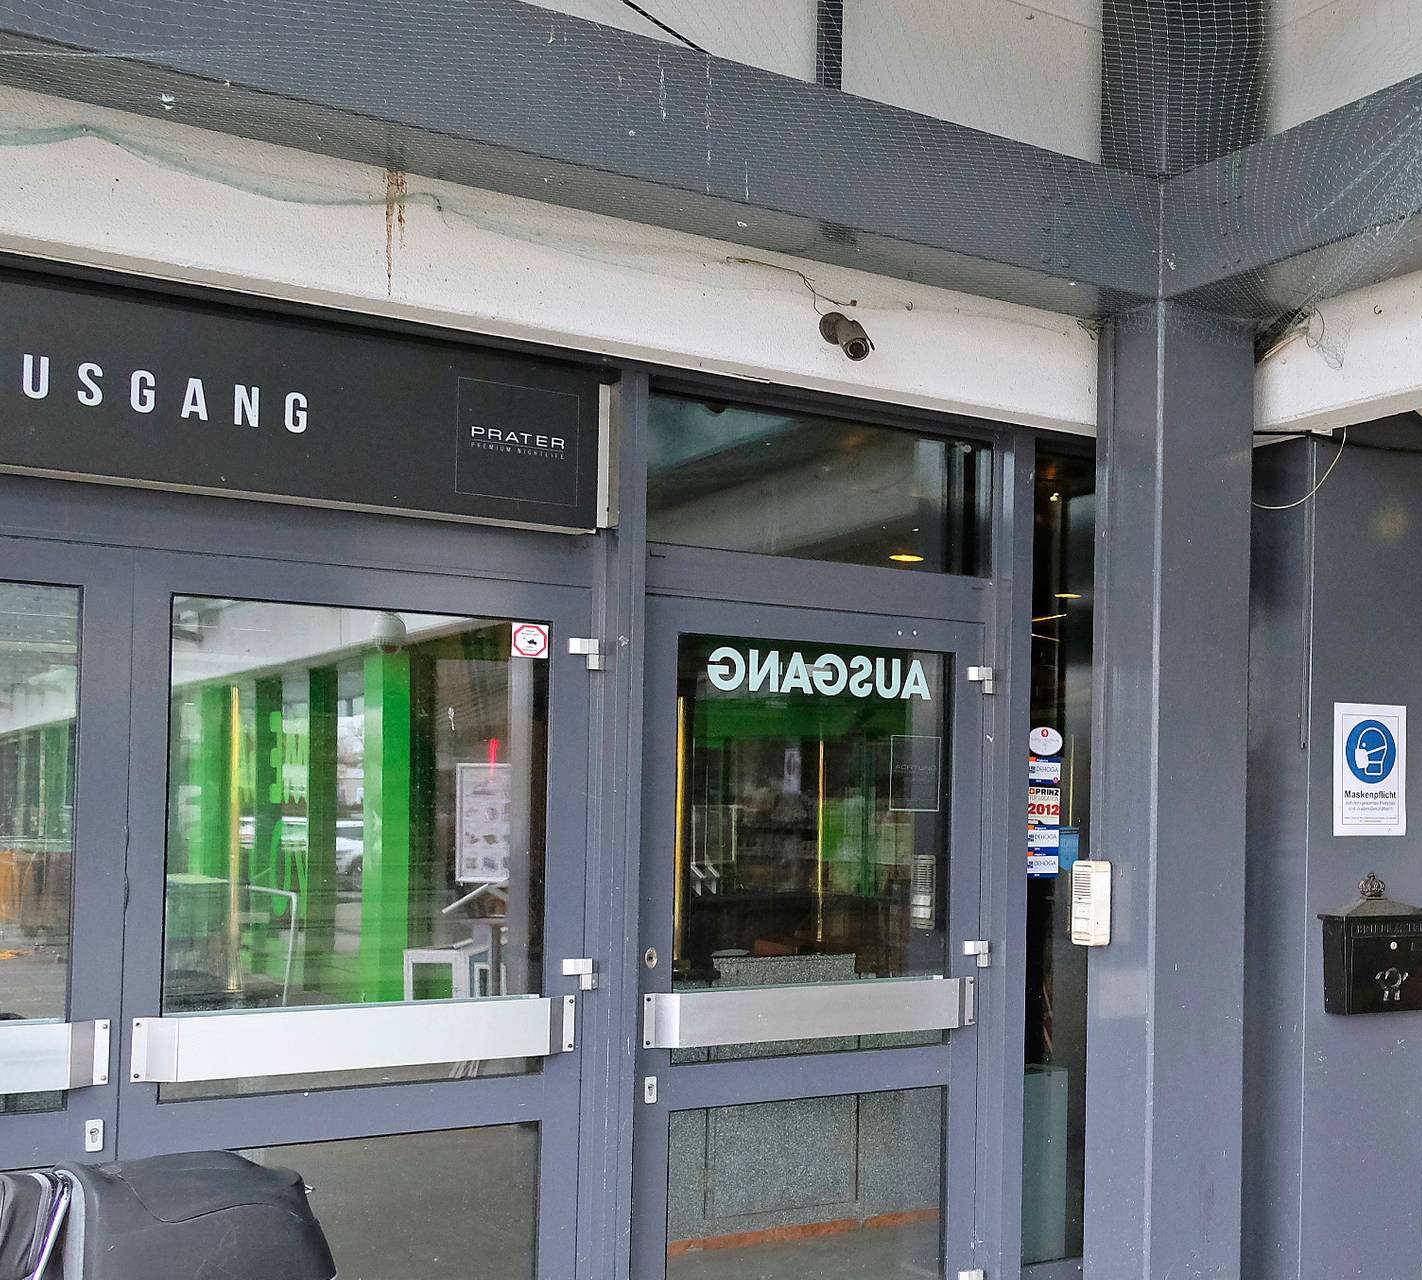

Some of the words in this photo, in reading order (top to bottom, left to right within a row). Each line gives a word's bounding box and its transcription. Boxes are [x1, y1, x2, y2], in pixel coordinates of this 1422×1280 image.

[471, 426, 565, 449] PRATER
[1035, 788, 1060, 796] PRINZ
[1344, 790, 1397, 800] Maskenpflicht
[1028, 803, 1062, 815] 2012
